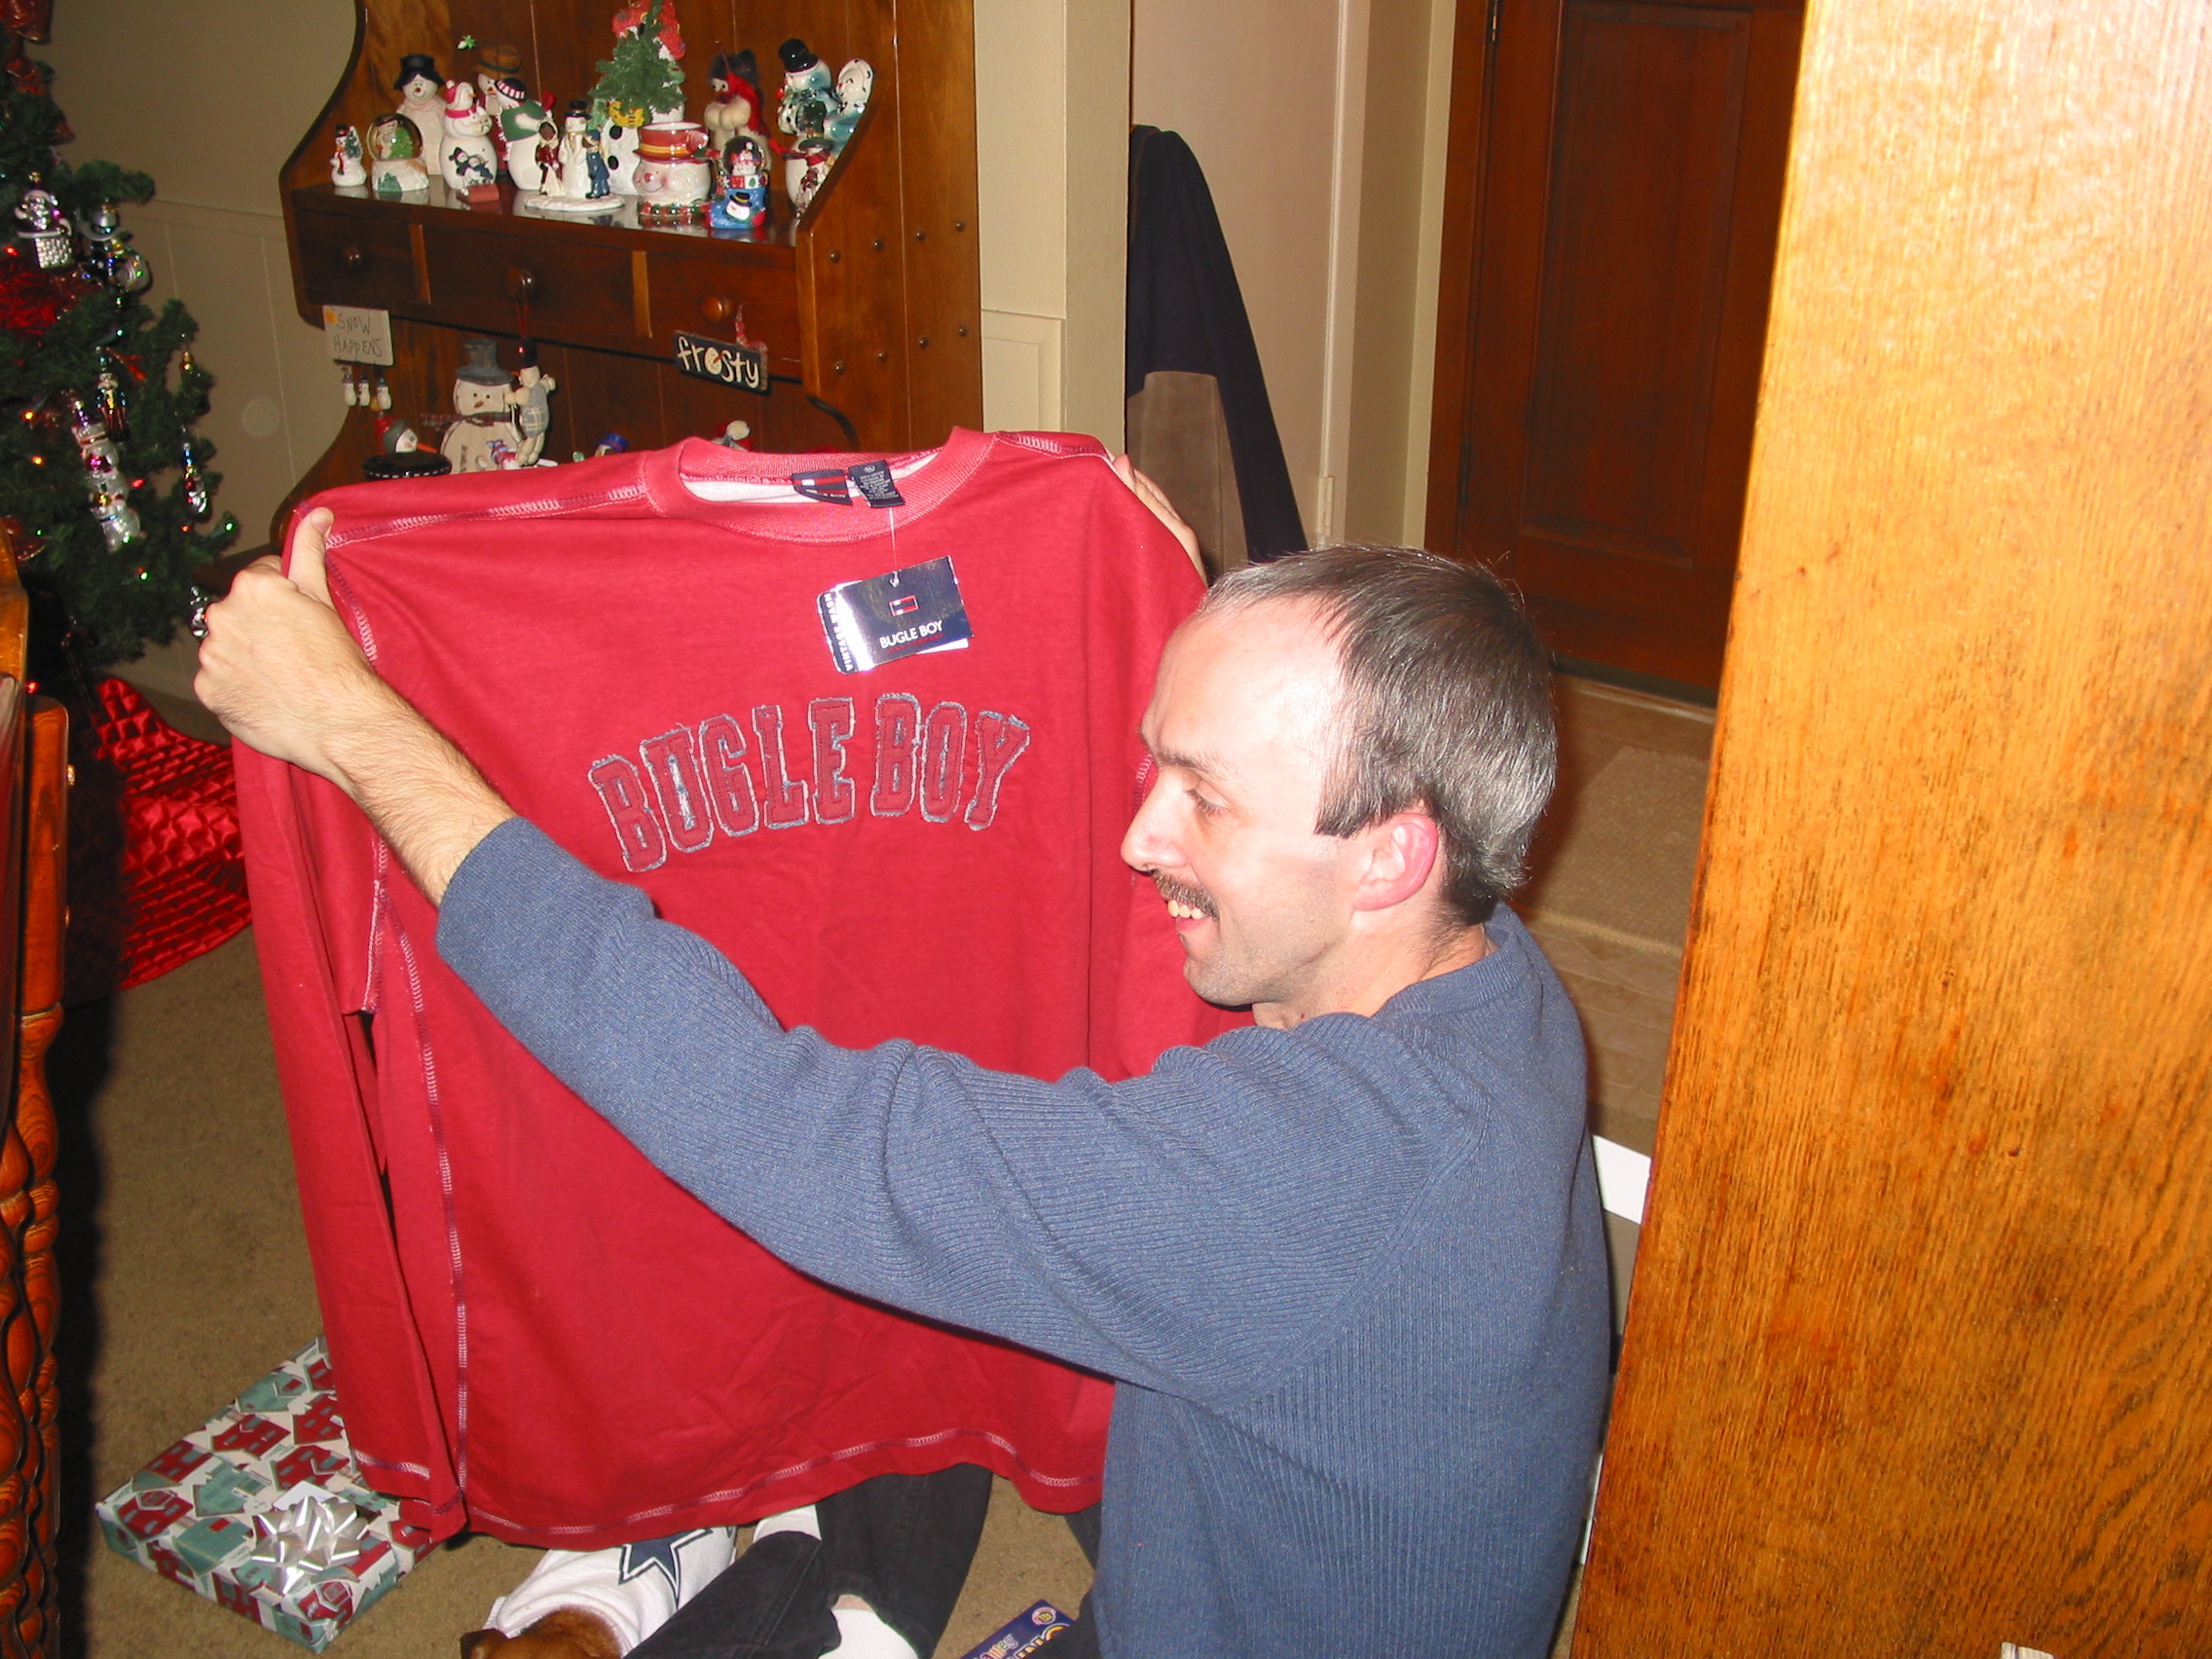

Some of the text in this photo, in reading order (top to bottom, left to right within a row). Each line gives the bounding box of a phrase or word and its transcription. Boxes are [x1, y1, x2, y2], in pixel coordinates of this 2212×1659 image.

[336, 313, 371, 334] SNOW
[333, 336, 383, 357] HAPPENS
[677, 335, 759, 388] frosty
[878, 627, 919, 649] BUGLE
[918, 619, 943, 638] BOY
[587, 692, 1030, 872] BUGLE BOY
